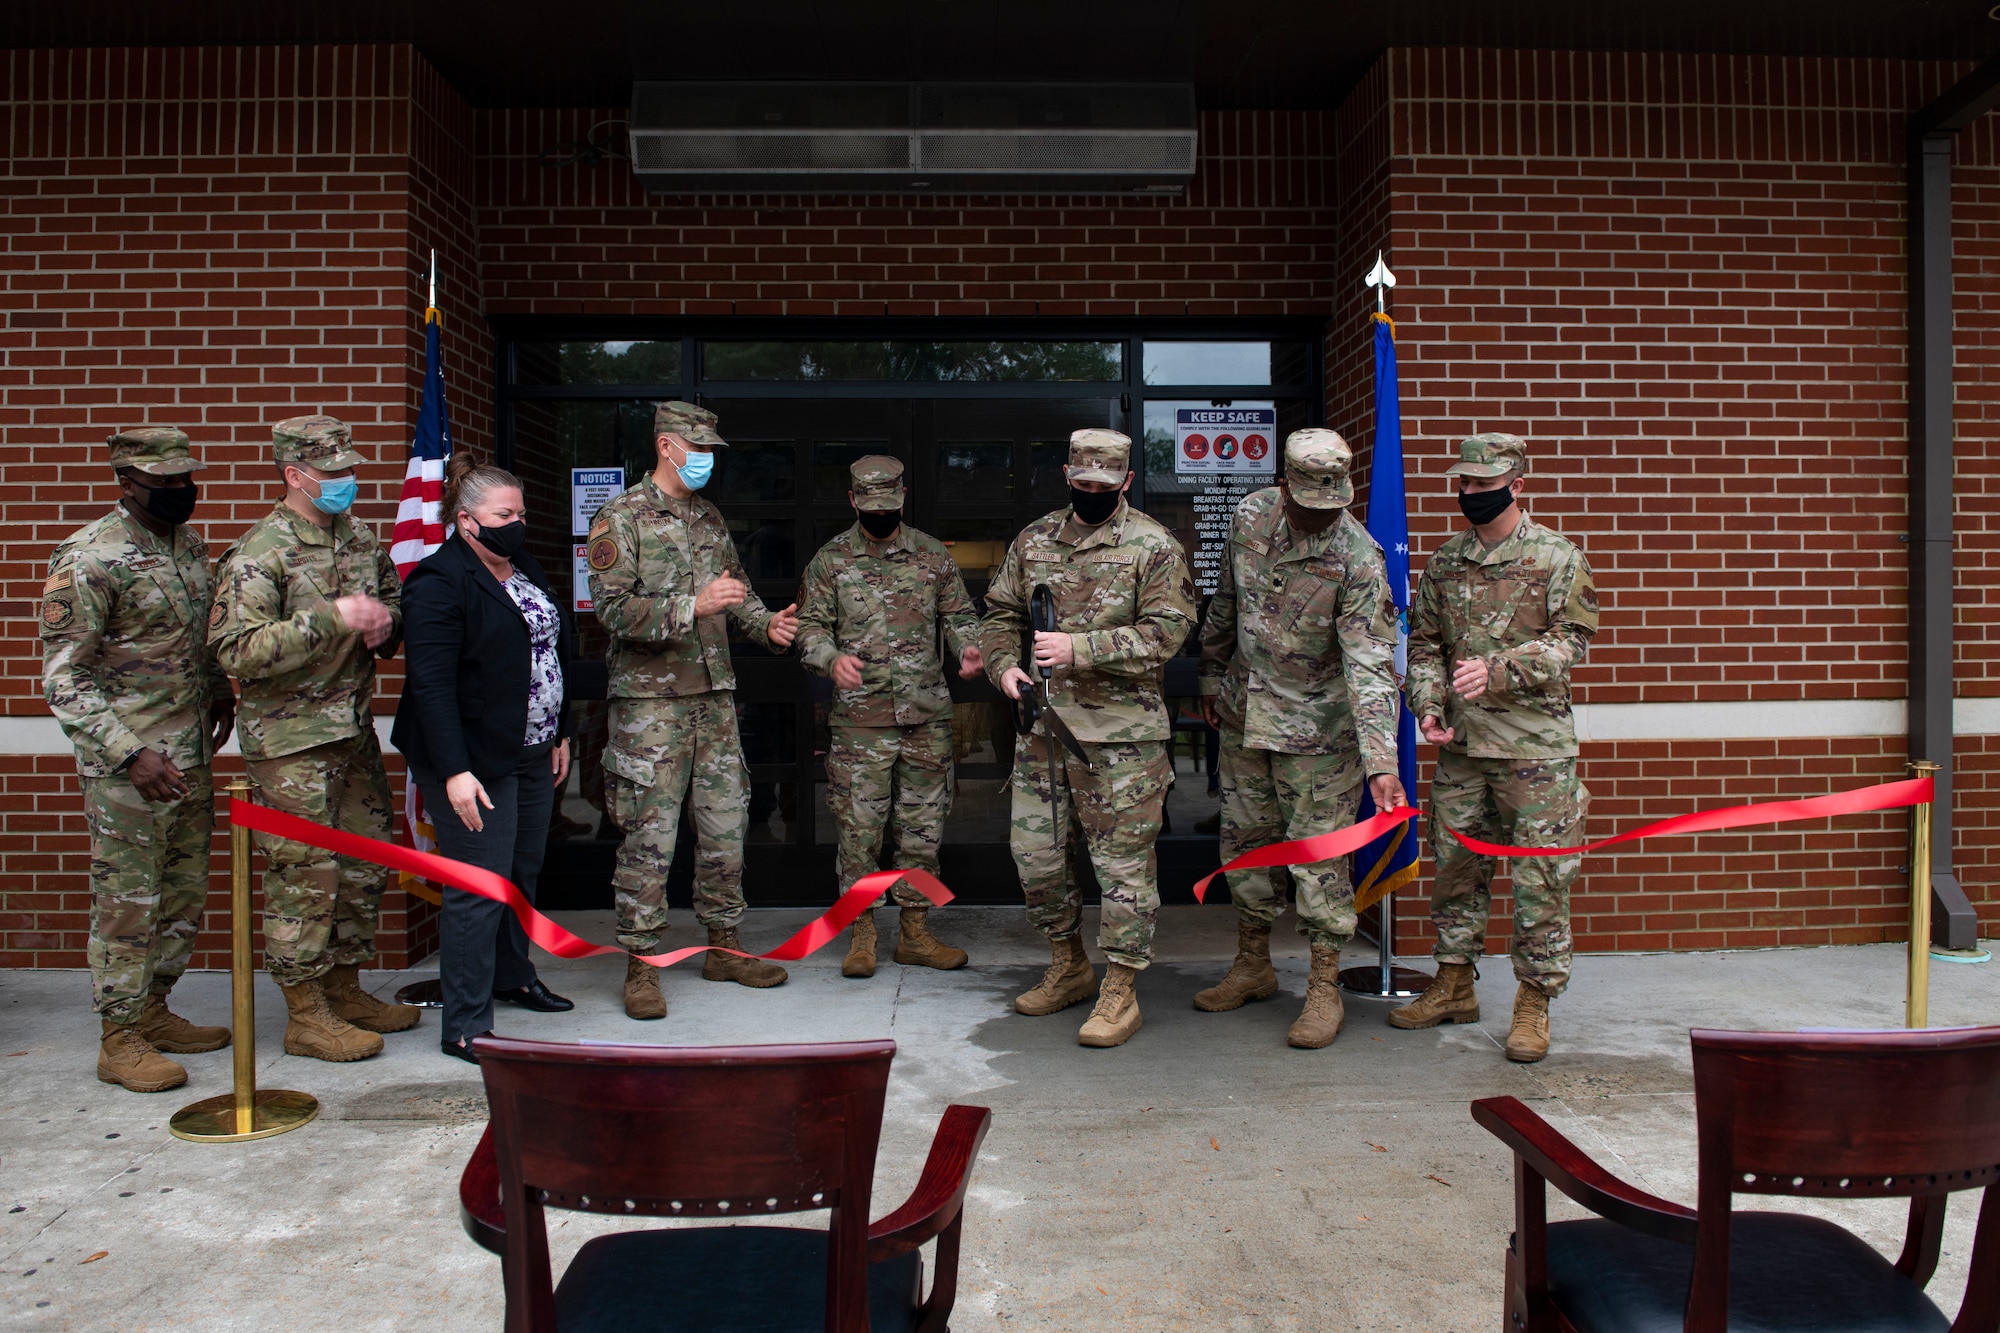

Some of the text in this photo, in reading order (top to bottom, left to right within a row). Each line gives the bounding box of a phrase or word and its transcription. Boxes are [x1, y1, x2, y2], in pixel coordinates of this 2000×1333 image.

[1191, 412, 1260, 423] KEEP SAFE
[580, 474, 616, 484] NOTICE
